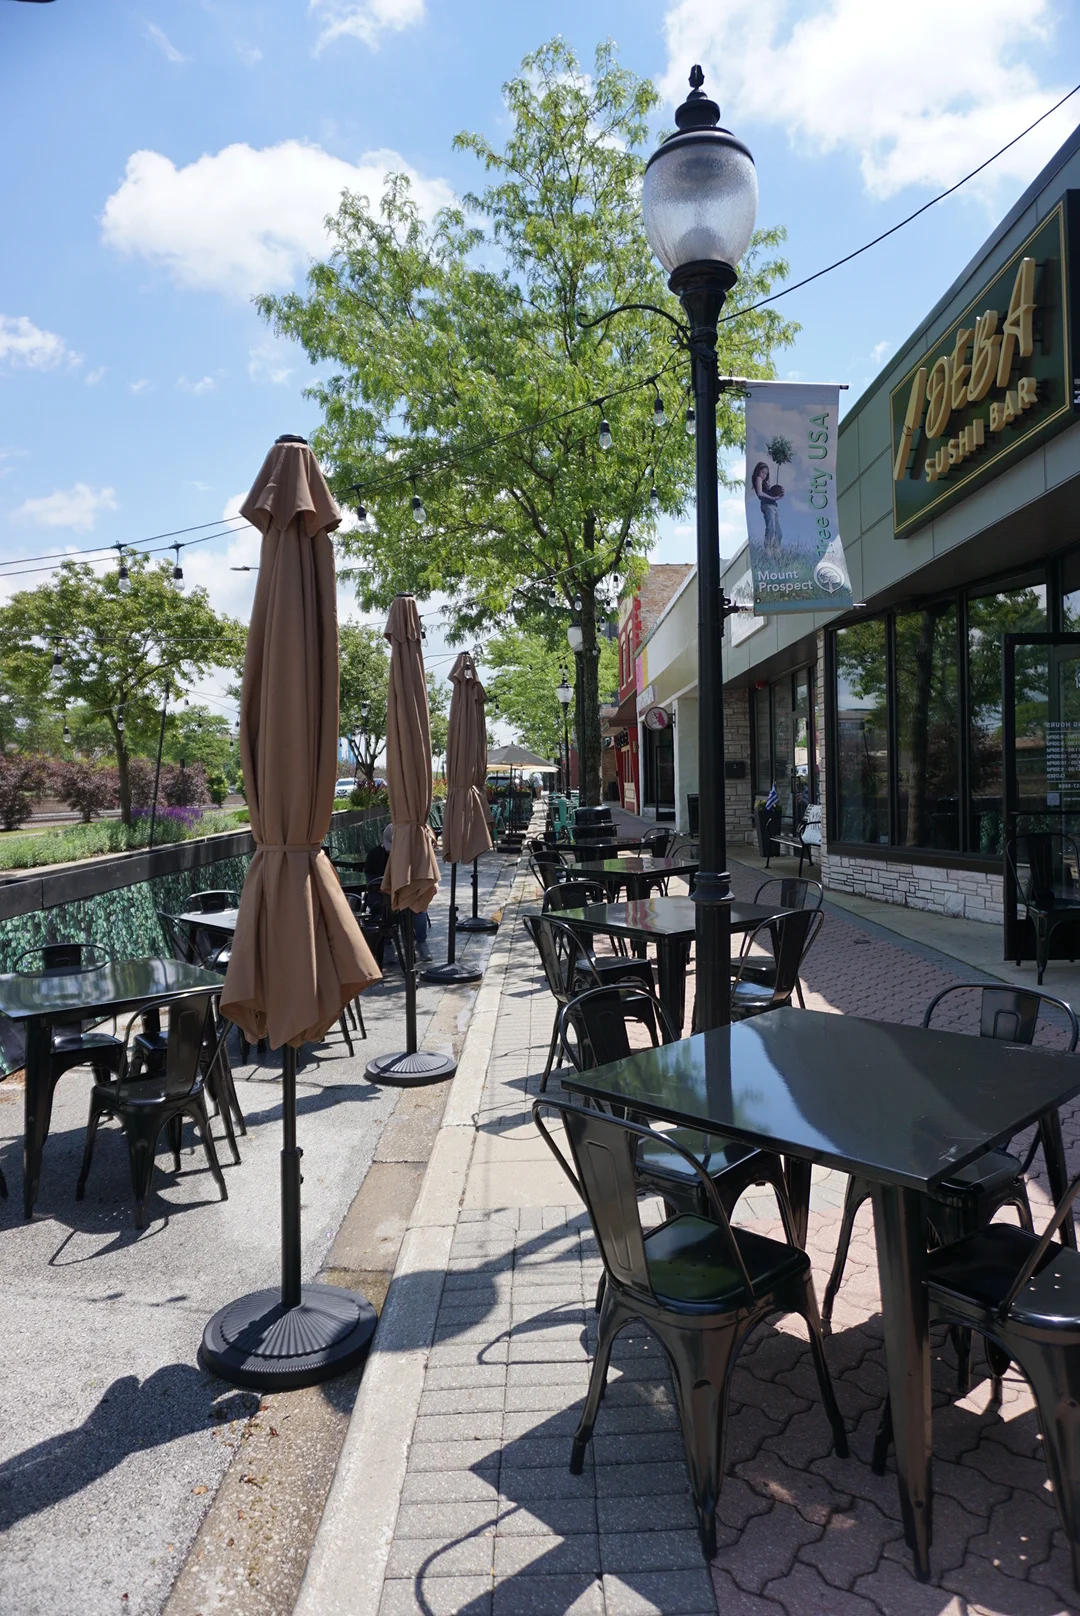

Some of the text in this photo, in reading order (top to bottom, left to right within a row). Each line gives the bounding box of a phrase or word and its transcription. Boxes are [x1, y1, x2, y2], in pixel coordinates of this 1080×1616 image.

[925, 418, 985, 483] SUSHI
[989, 377, 1038, 432] BAR
[807, 412, 835, 557] Tree City USA
[757, 570, 799, 581] Mount
[758, 580, 814, 594] Prospect
